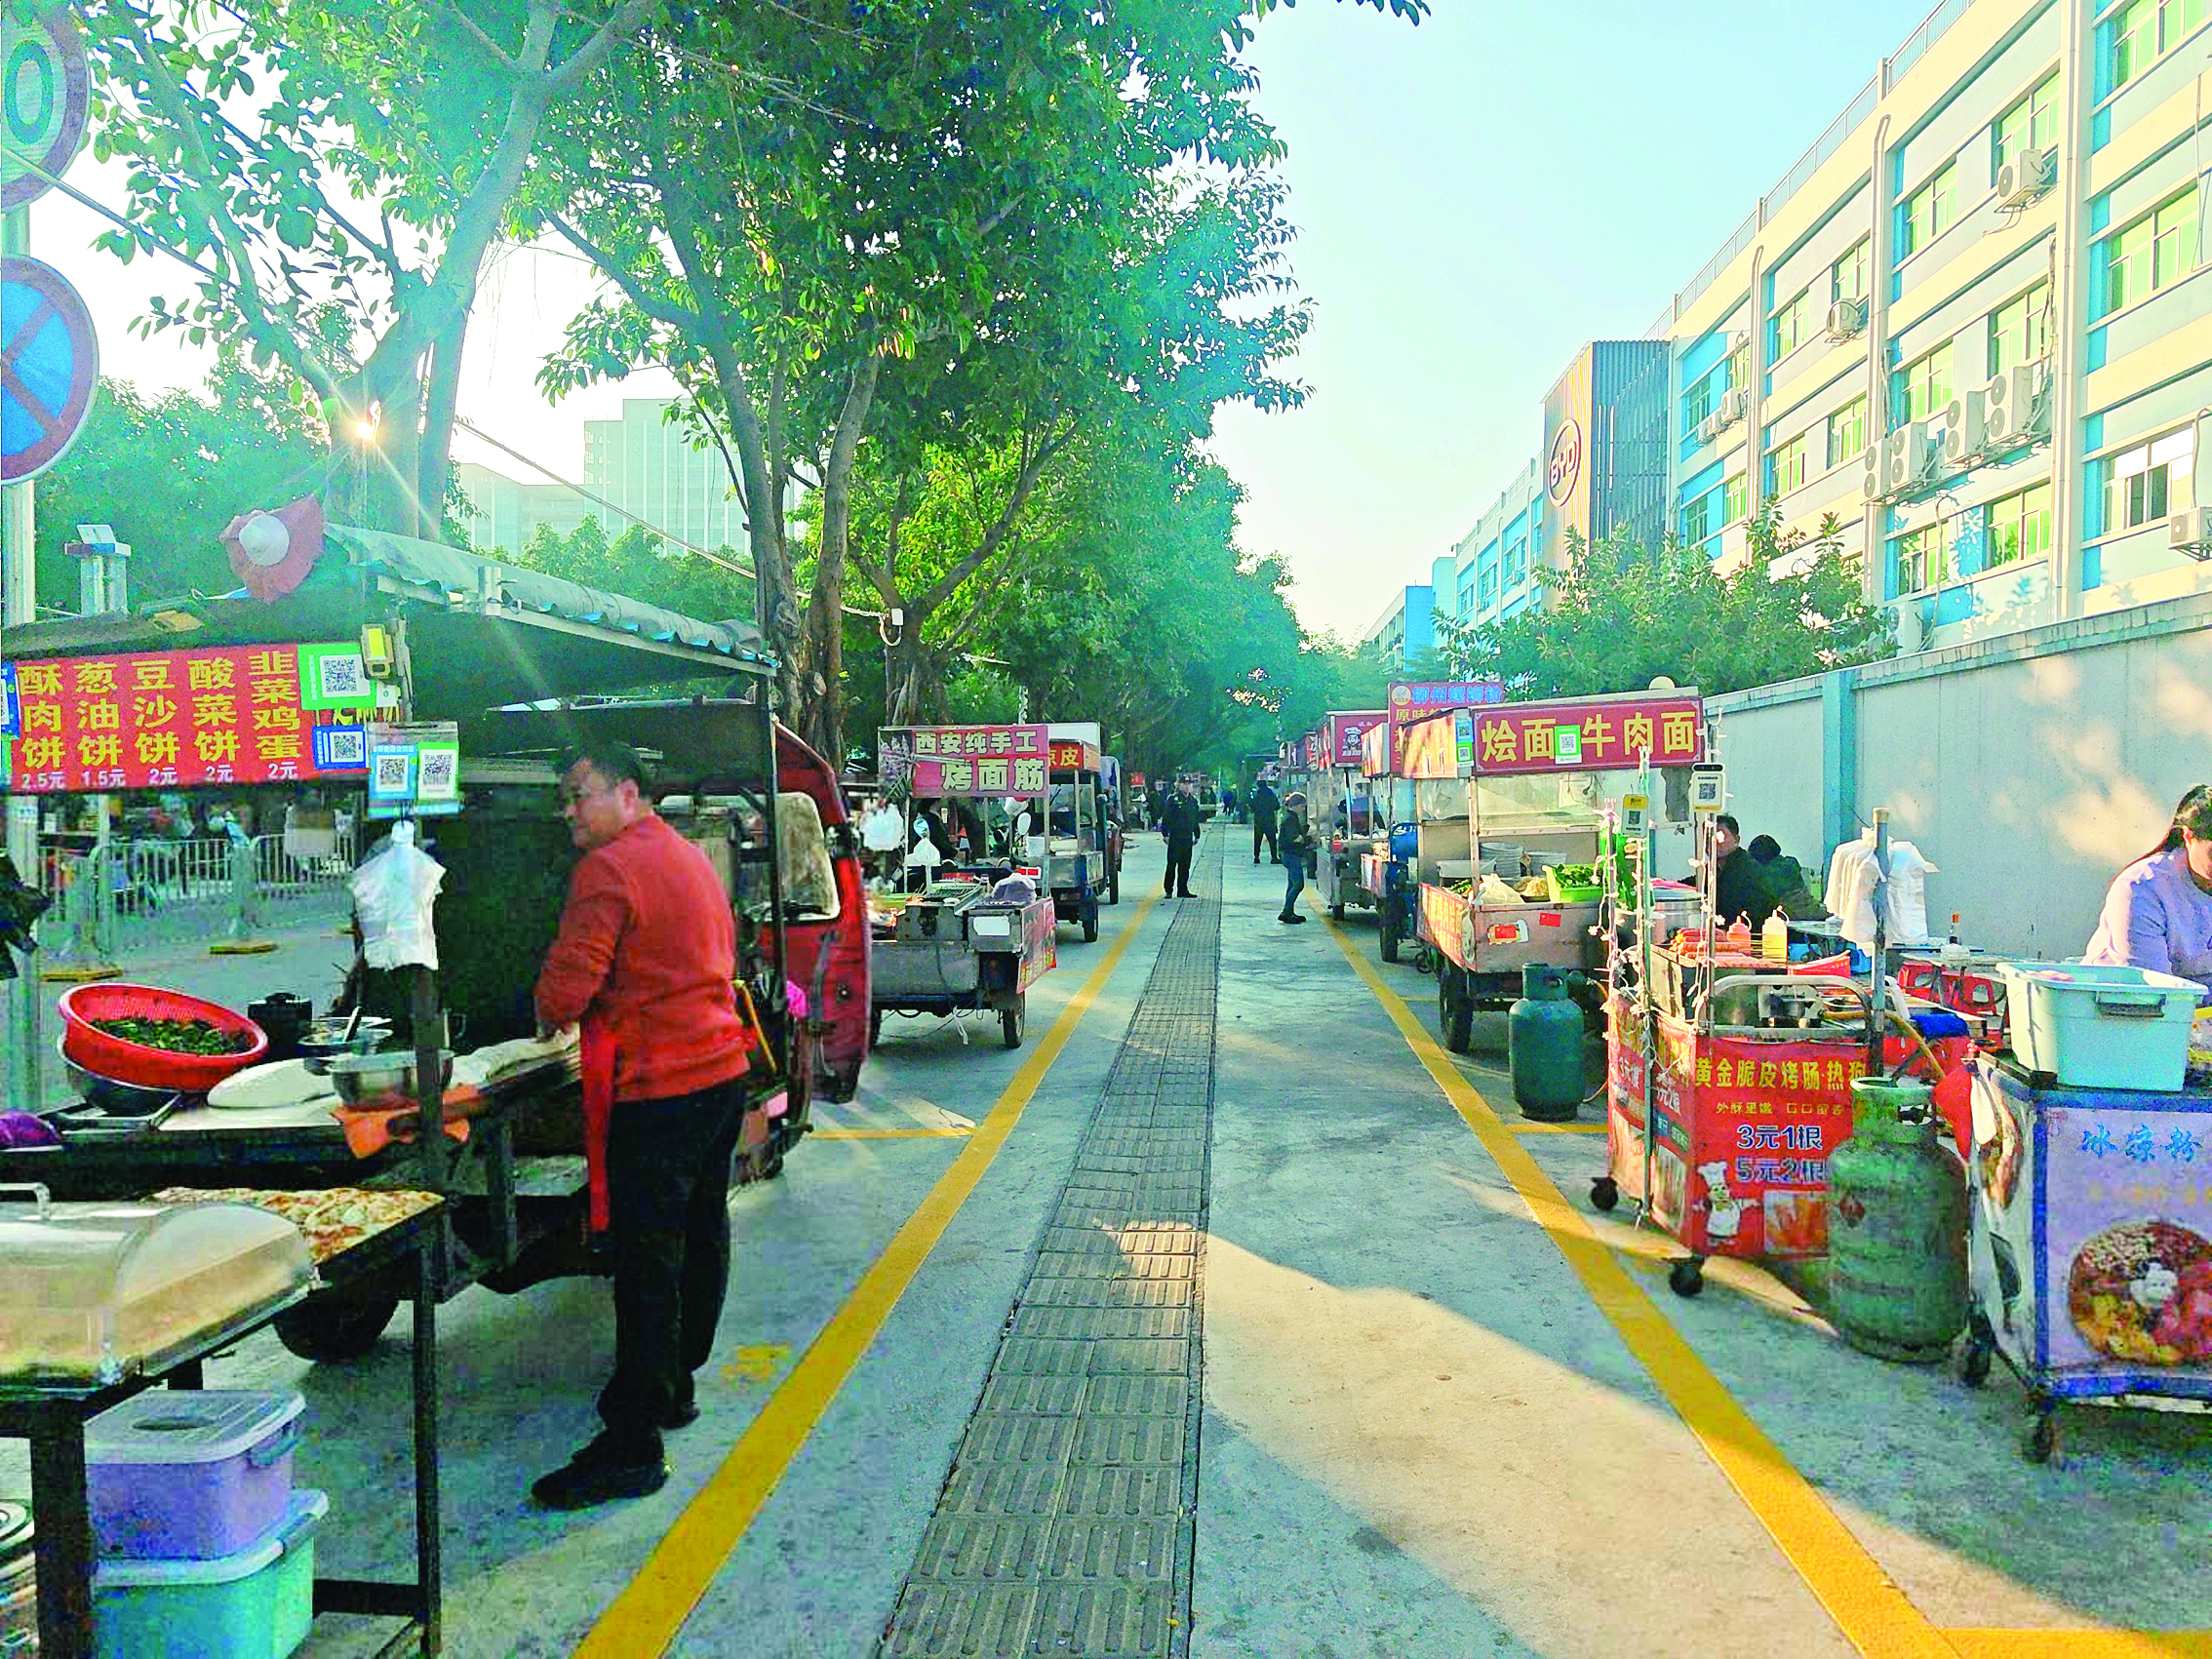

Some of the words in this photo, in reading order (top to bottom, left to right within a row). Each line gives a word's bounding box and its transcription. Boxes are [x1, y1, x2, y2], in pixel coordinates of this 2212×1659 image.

[1550, 440, 1578, 488] BYD
[18, 663, 66, 770] 酥肉饼
[73, 661, 124, 767] 葱油饼
[131, 659, 181, 765] 豆沙饼
[186, 656, 241, 763] 酸菜饼
[248, 651, 303, 761] 韭菜鸡蛋
[915, 731, 1039, 755] 西安纯手工
[21, 770, 65, 789] 2.5元
[82, 769, 126, 786] 1.5元
[149, 767, 178, 785] 2元
[205, 764, 234, 783] 2元
[268, 762, 297, 780] 2元
[940, 758, 1045, 792] 烤面筋
[1736, 1124, 1823, 1150] 3元1根
